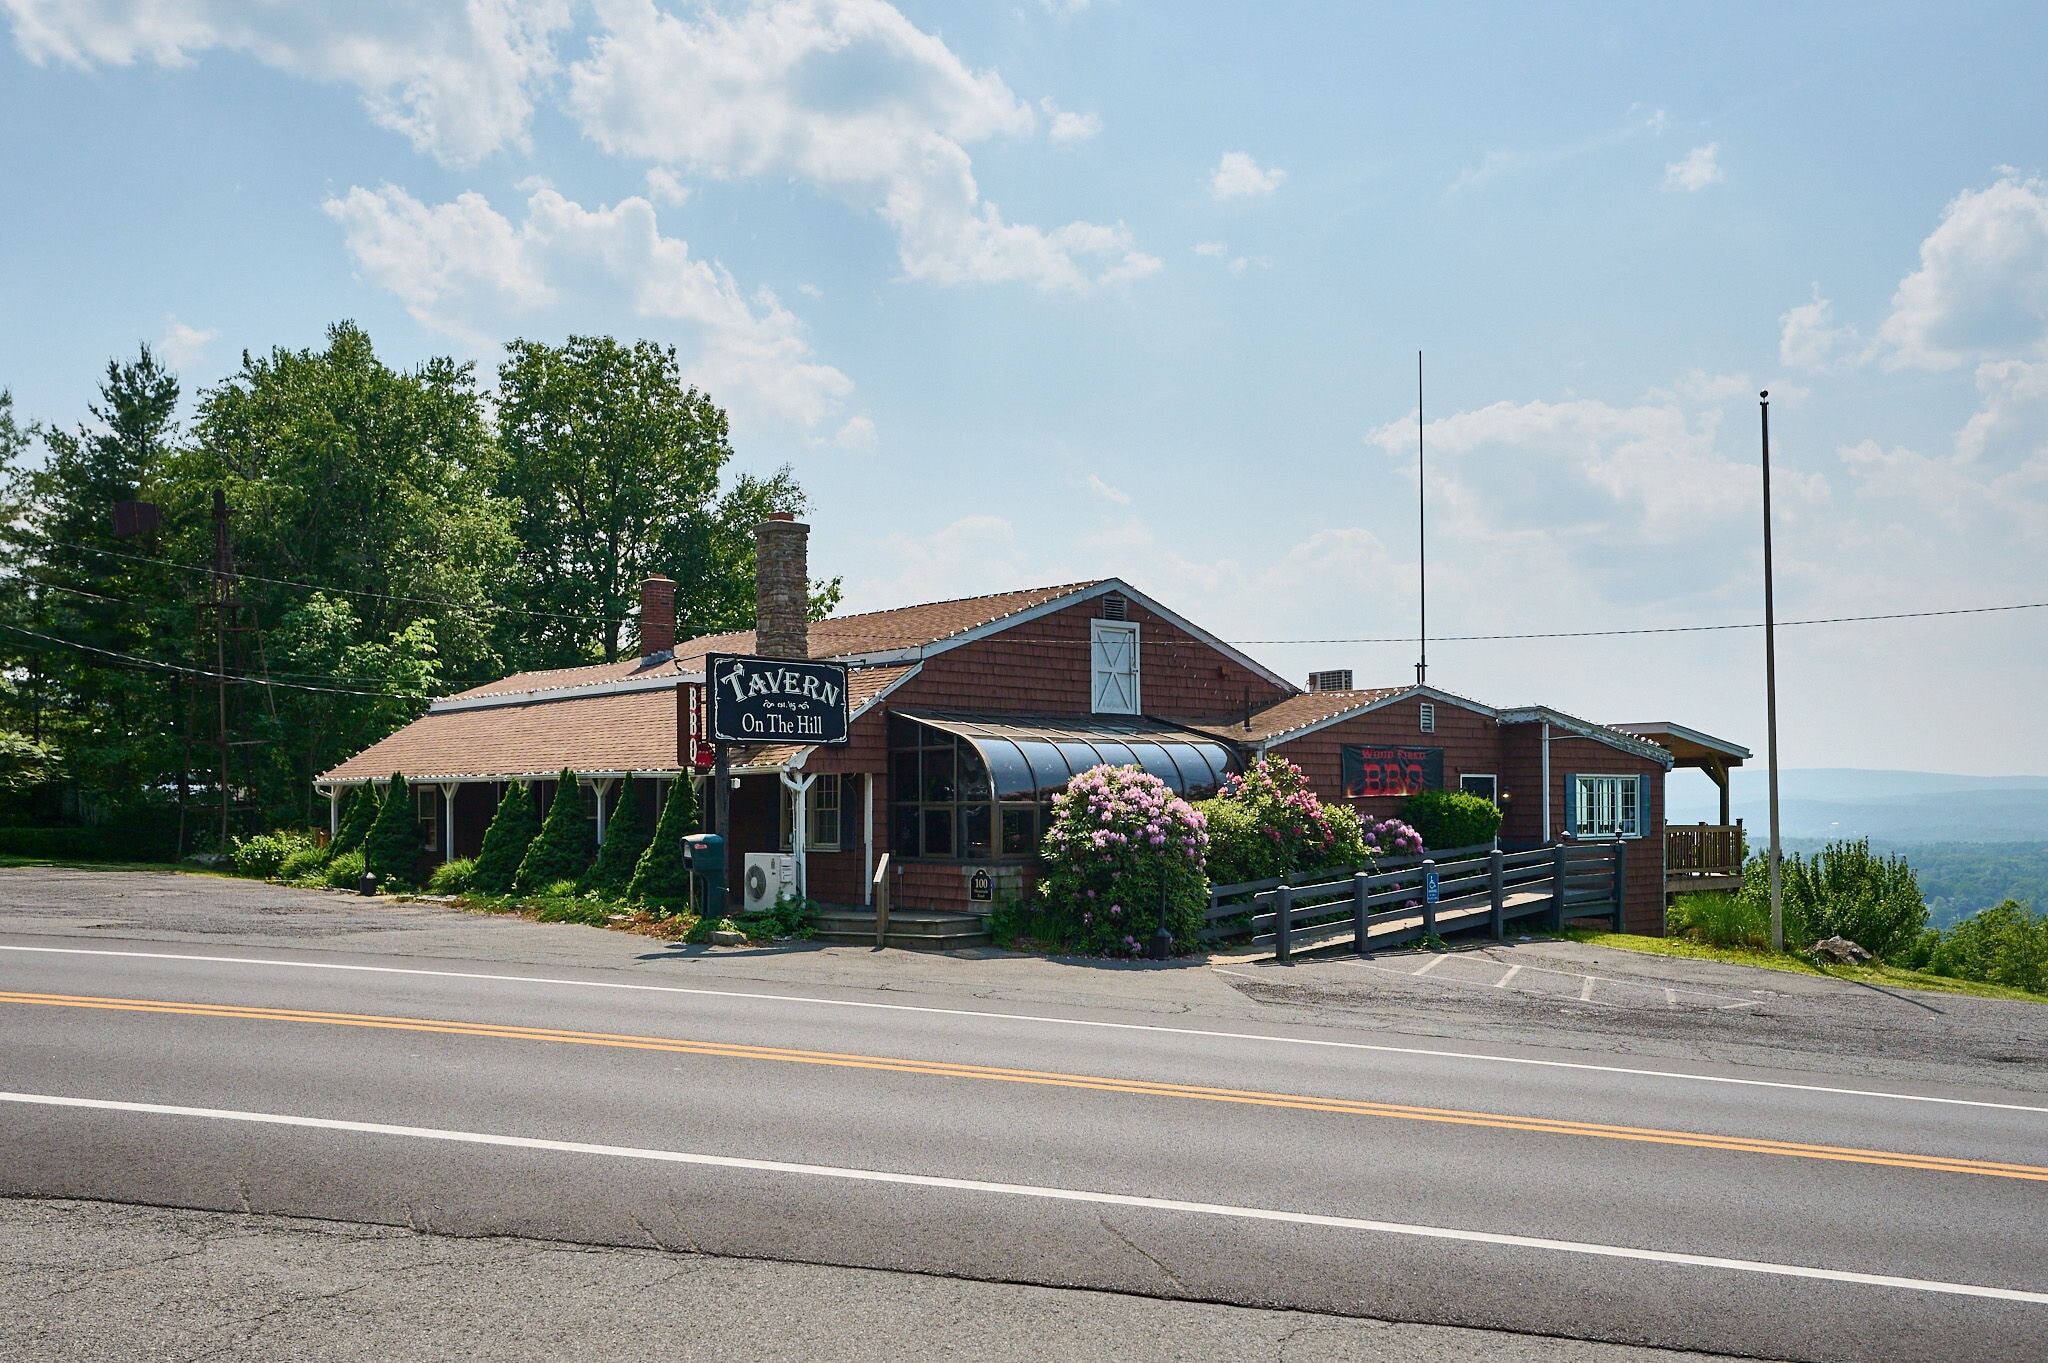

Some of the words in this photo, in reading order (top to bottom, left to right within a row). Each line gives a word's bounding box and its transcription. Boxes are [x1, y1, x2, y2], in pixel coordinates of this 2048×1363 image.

[720, 663, 840, 707] TAVERN
[689, 686, 698, 764] BBQ
[742, 713, 764, 732] On
[767, 714, 794, 733] The
[797, 715, 822, 734] Hill
[1364, 763, 1424, 795] BBQ
[975, 879, 988, 888] 100
